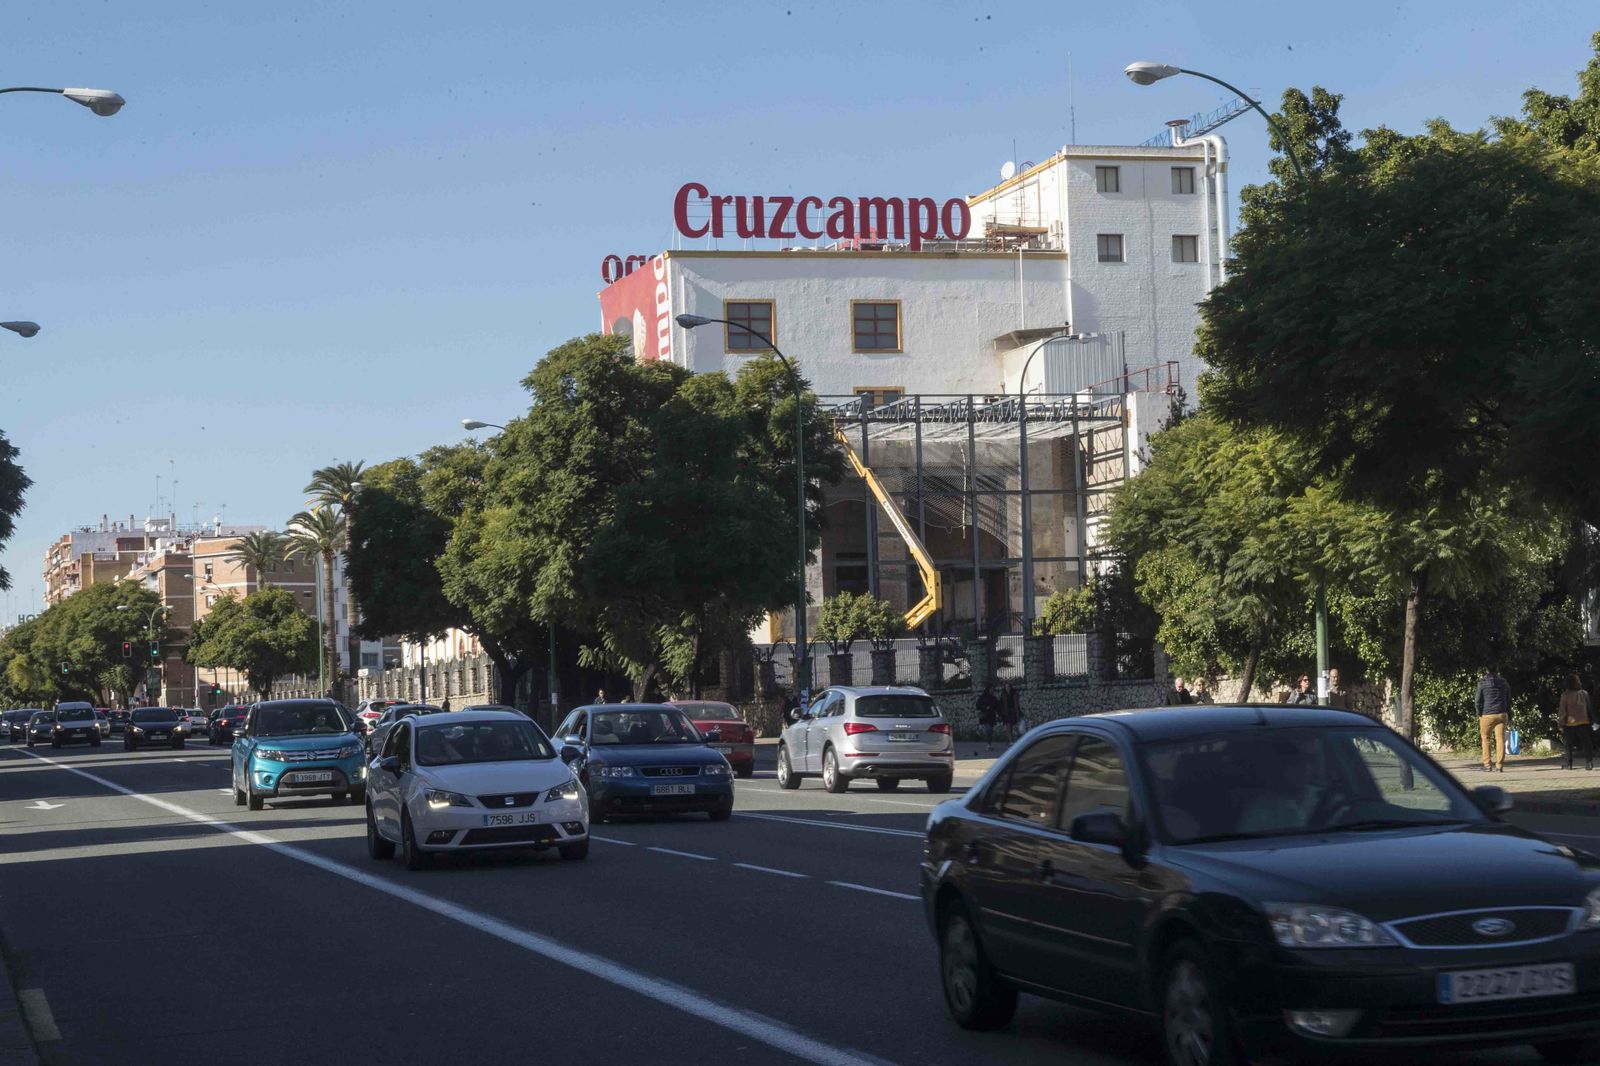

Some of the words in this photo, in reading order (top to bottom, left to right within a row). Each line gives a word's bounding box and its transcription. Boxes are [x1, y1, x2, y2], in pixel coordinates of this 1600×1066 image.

[673, 182, 971, 251] Cruzcampo
[490, 814, 514, 825] 7596
[518, 813, 536, 824] JJS
